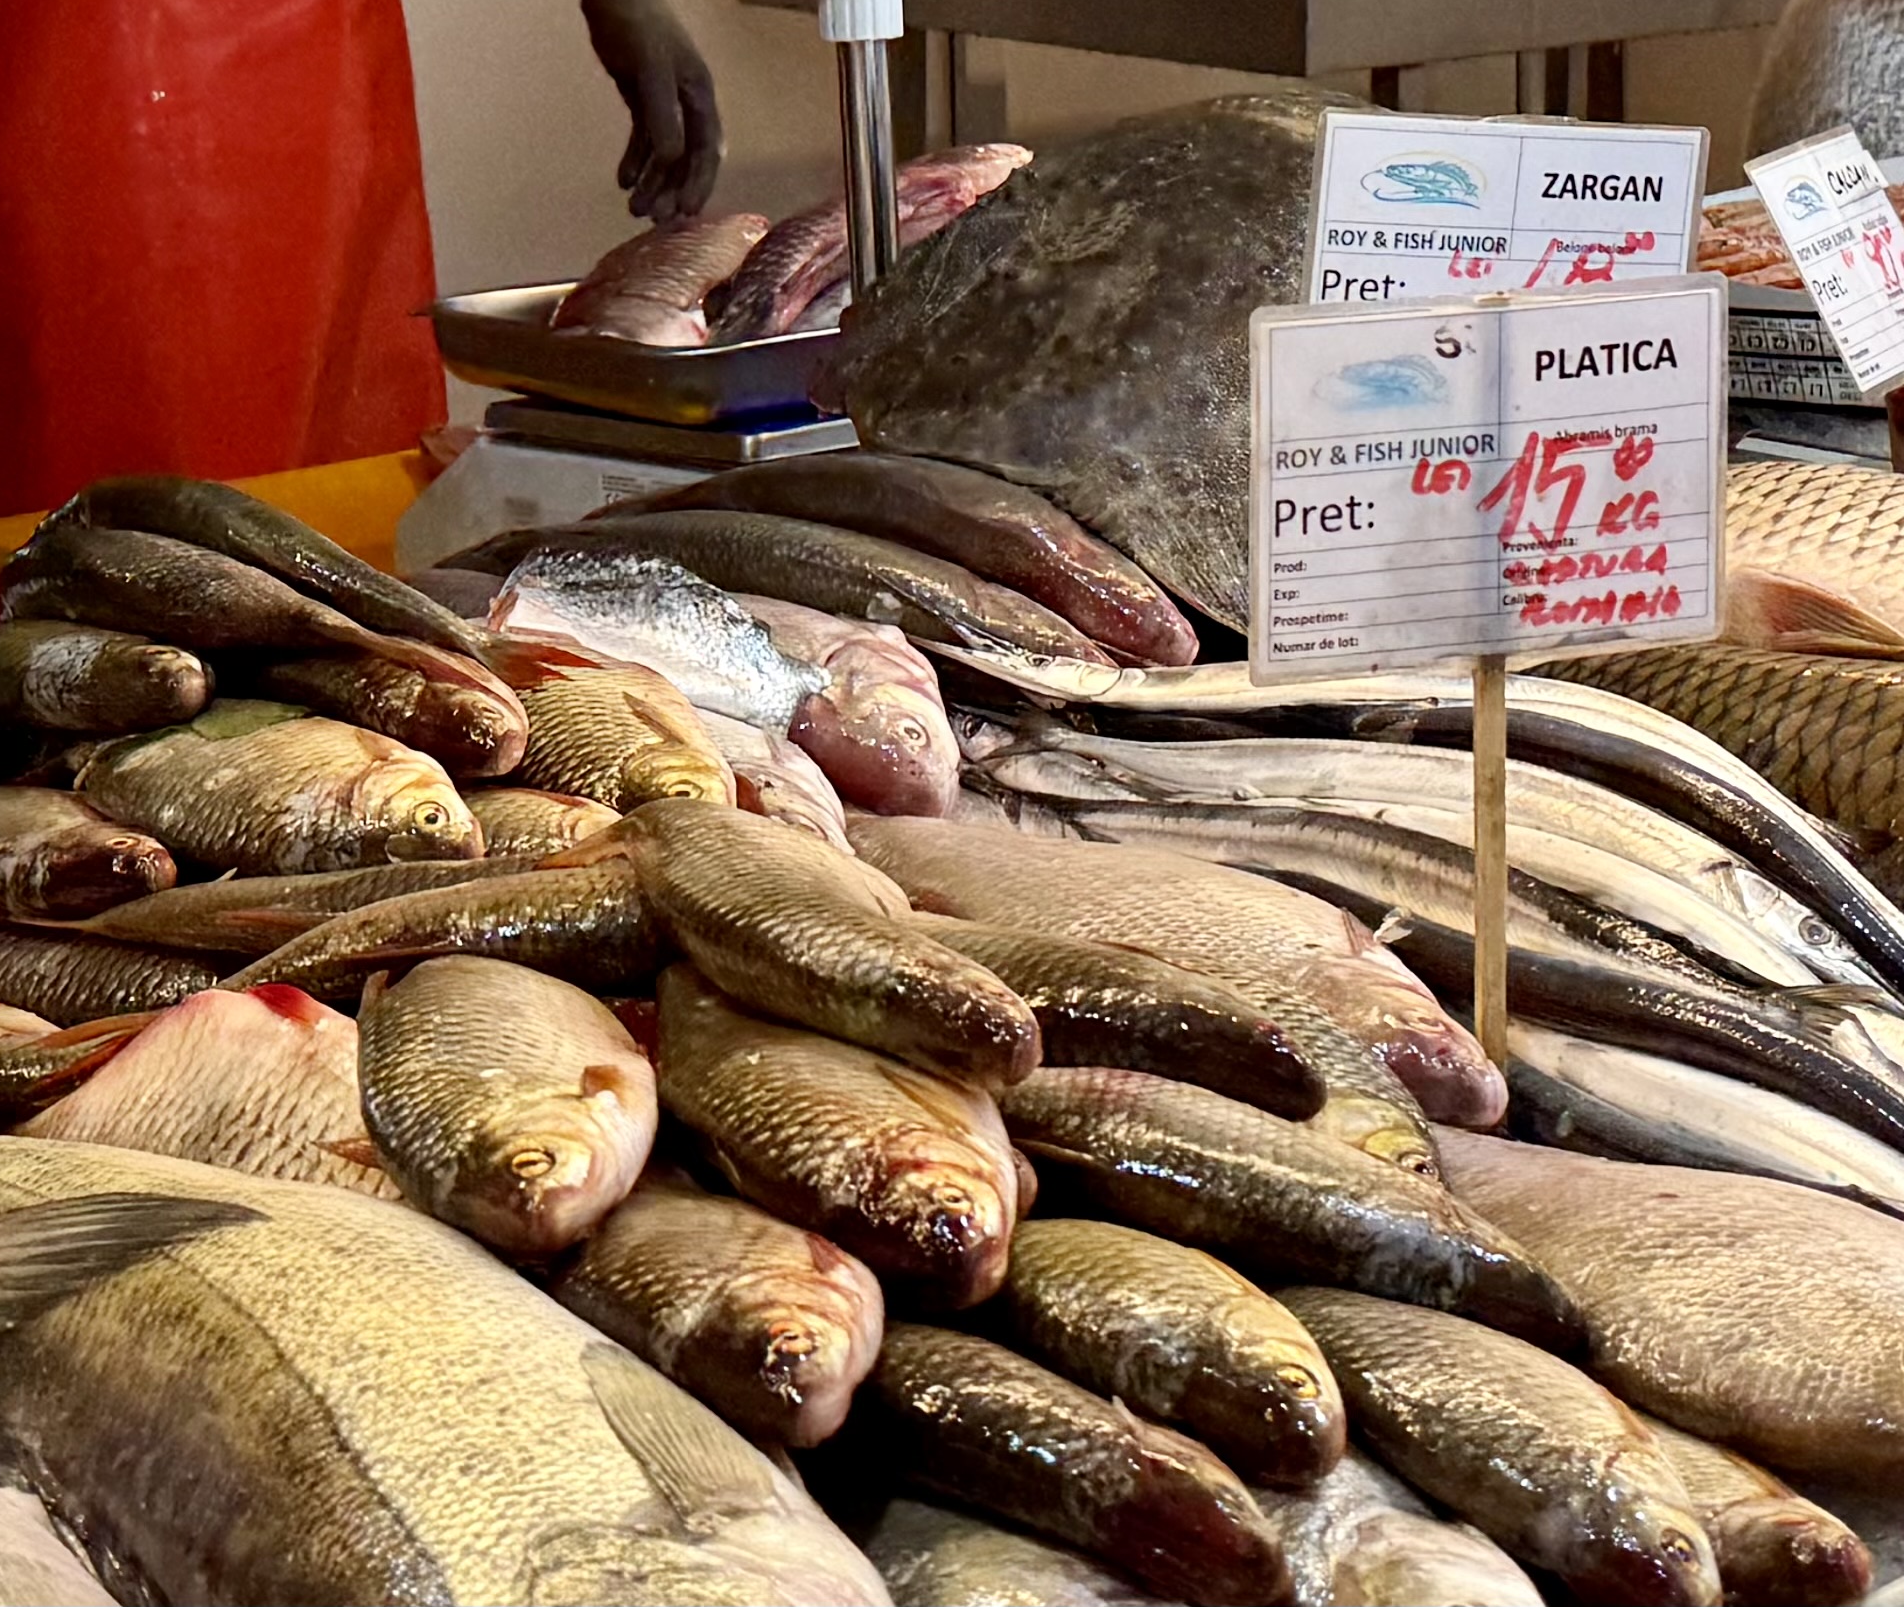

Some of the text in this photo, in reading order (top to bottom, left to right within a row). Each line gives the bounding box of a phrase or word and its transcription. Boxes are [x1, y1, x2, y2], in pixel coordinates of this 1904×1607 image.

[1541, 173, 1663, 202] ZARGAN
[1328, 229, 1507, 253] ROY & FISH JUNIOR
[1534, 338, 1677, 382] PLATICA
[1614, 423, 1658, 437] brama
[1276, 433, 1496, 471] ROY & FISH JUNIOR
[1476, 431, 1613, 555] 15
[1273, 494, 1375, 538] Pret:
[1596, 490, 1660, 536] KG
[1274, 560, 1307, 573] Prod:
[1274, 589, 1300, 601] Exp:
[1274, 612, 1349, 627] Prospetime:
[1273, 637, 1359, 653] Numar de lot:
